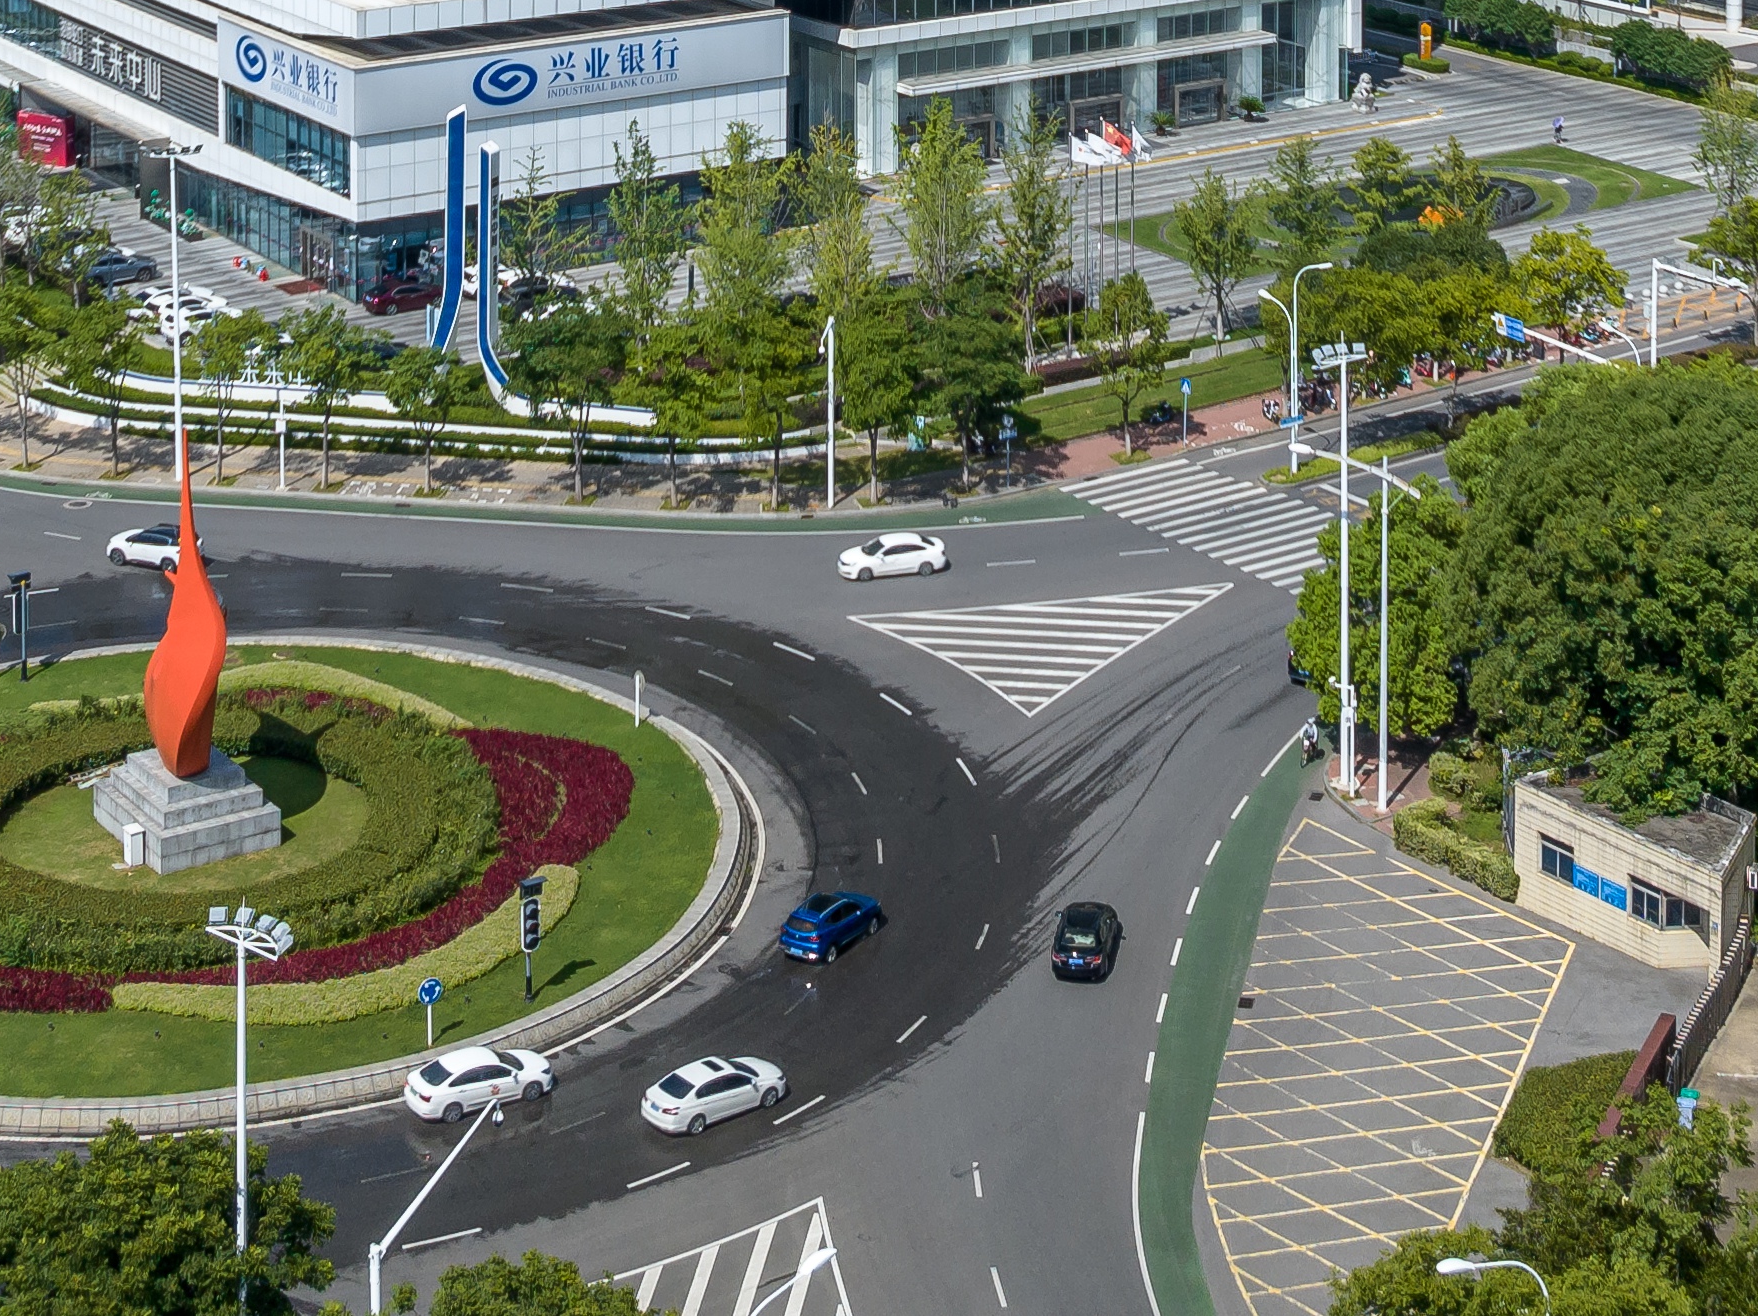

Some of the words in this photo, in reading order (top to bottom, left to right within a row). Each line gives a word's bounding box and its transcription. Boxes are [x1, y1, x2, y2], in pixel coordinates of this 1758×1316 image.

[90, 34, 162, 103] 未来中心
[270, 47, 339, 105] 兴业银行
[547, 37, 680, 85] 兴业银行
[547, 81, 608, 99] INDUSTRIAL
[610, 77, 638, 91] BANK
